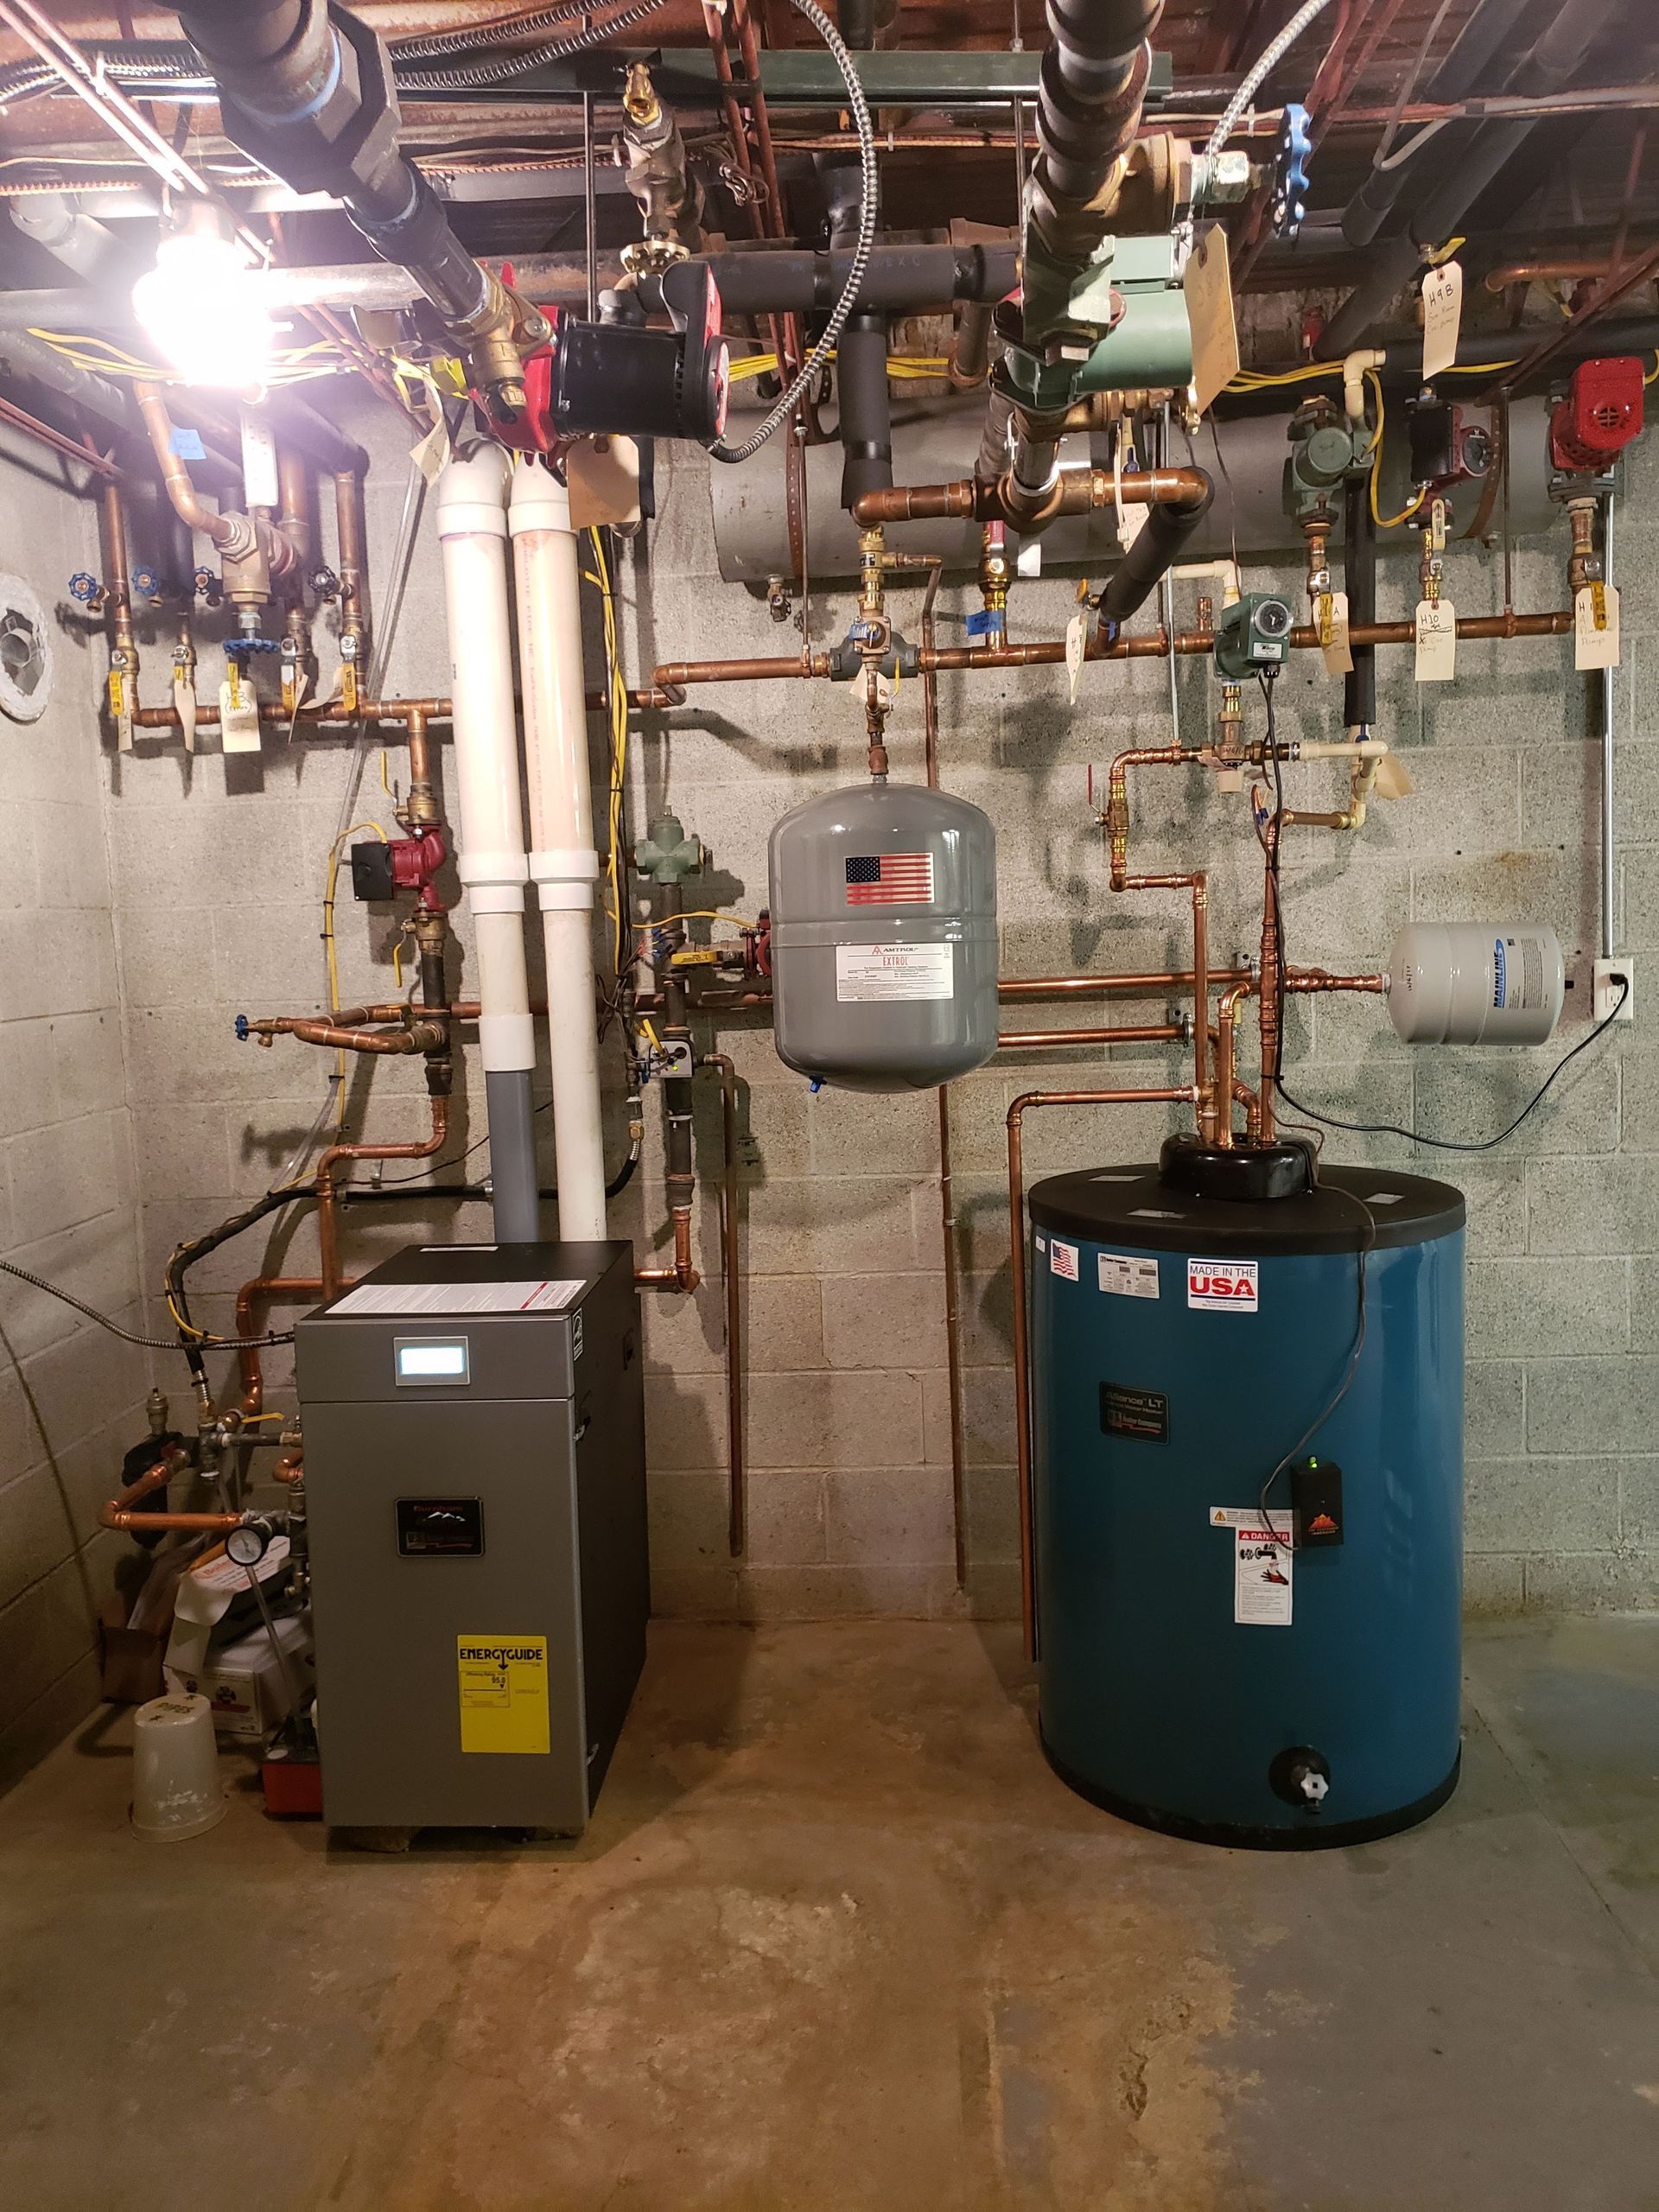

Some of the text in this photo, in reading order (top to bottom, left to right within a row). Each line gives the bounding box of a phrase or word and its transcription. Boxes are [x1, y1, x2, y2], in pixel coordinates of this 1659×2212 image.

[1420, 614, 1440, 625] H10
[882, 956, 908, 966] EXTROL
[1493, 950, 1504, 1008] MAINLINE
[1190, 1265, 1255, 1278] MADE IN THE
[1190, 1276, 1255, 1296] USA
[1147, 1398, 1163, 1408] LT
[459, 1648, 543, 1661] ENERGYGUIDE
